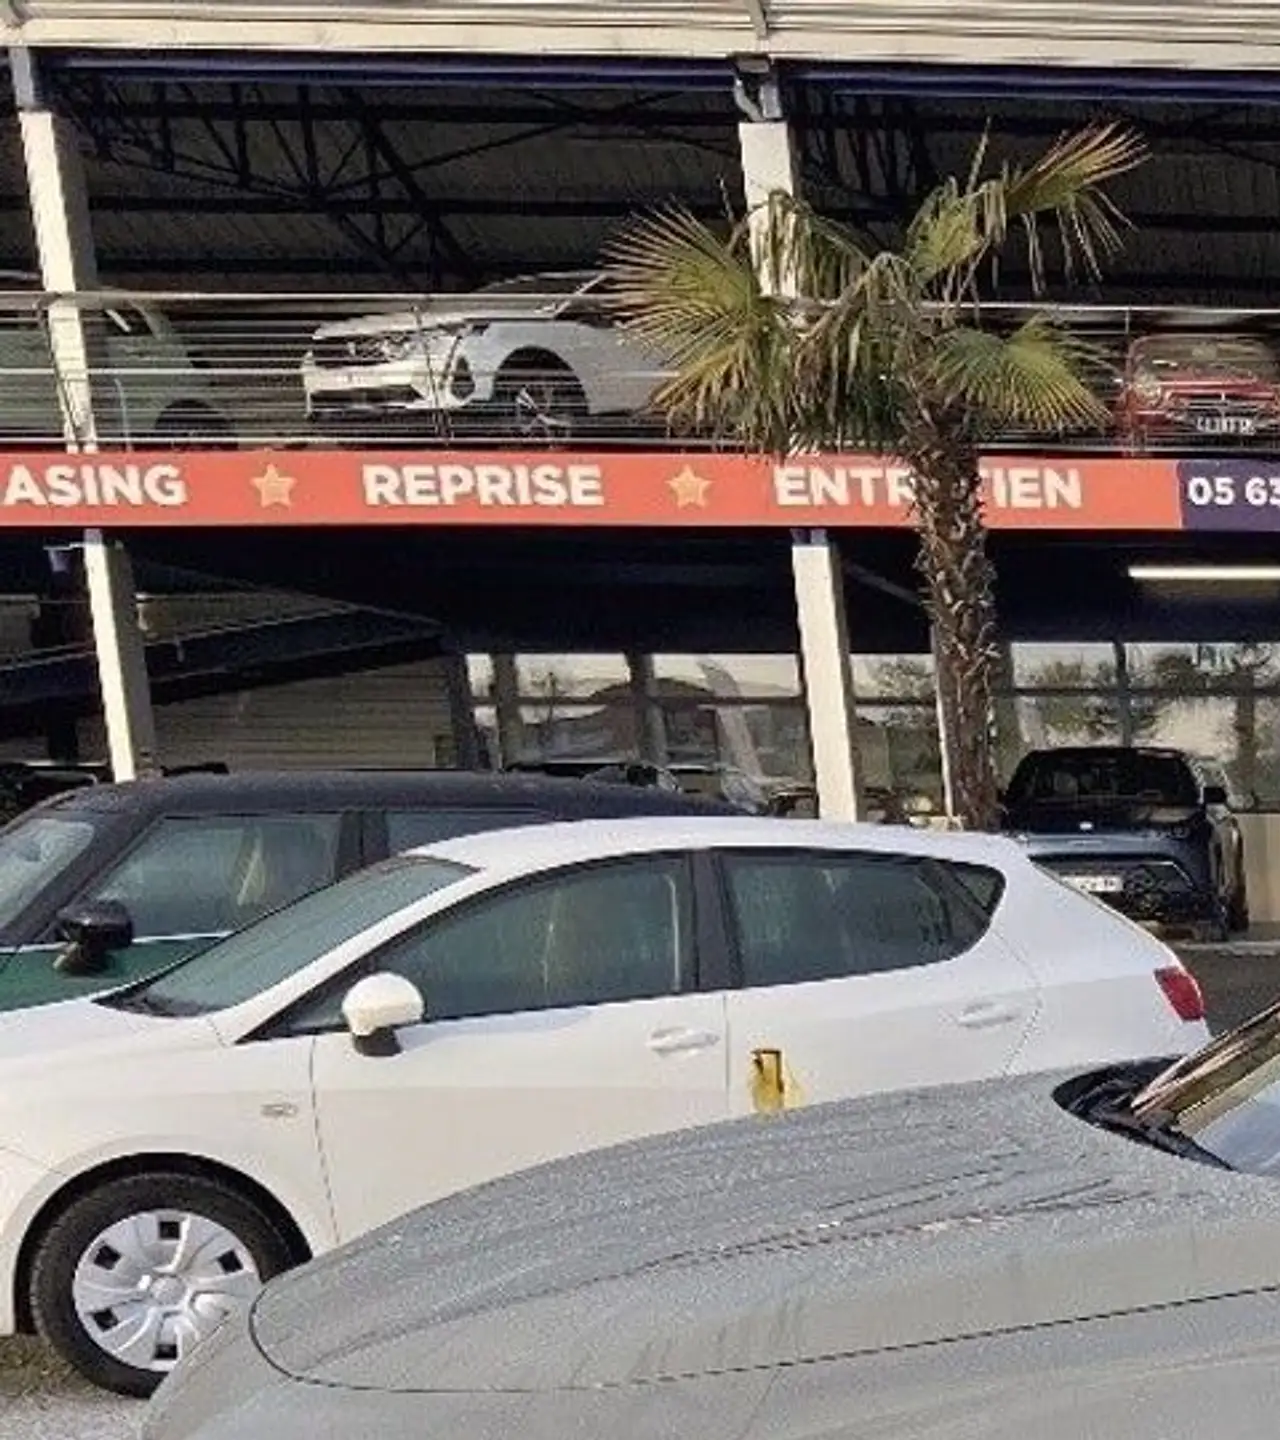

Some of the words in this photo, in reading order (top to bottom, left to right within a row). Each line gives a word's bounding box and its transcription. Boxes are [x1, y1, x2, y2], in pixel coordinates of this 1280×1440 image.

[361, 464, 604, 506] REPRISE
[774, 466, 1083, 509] ENTRIEN
[1188, 476, 1235, 506] 05
